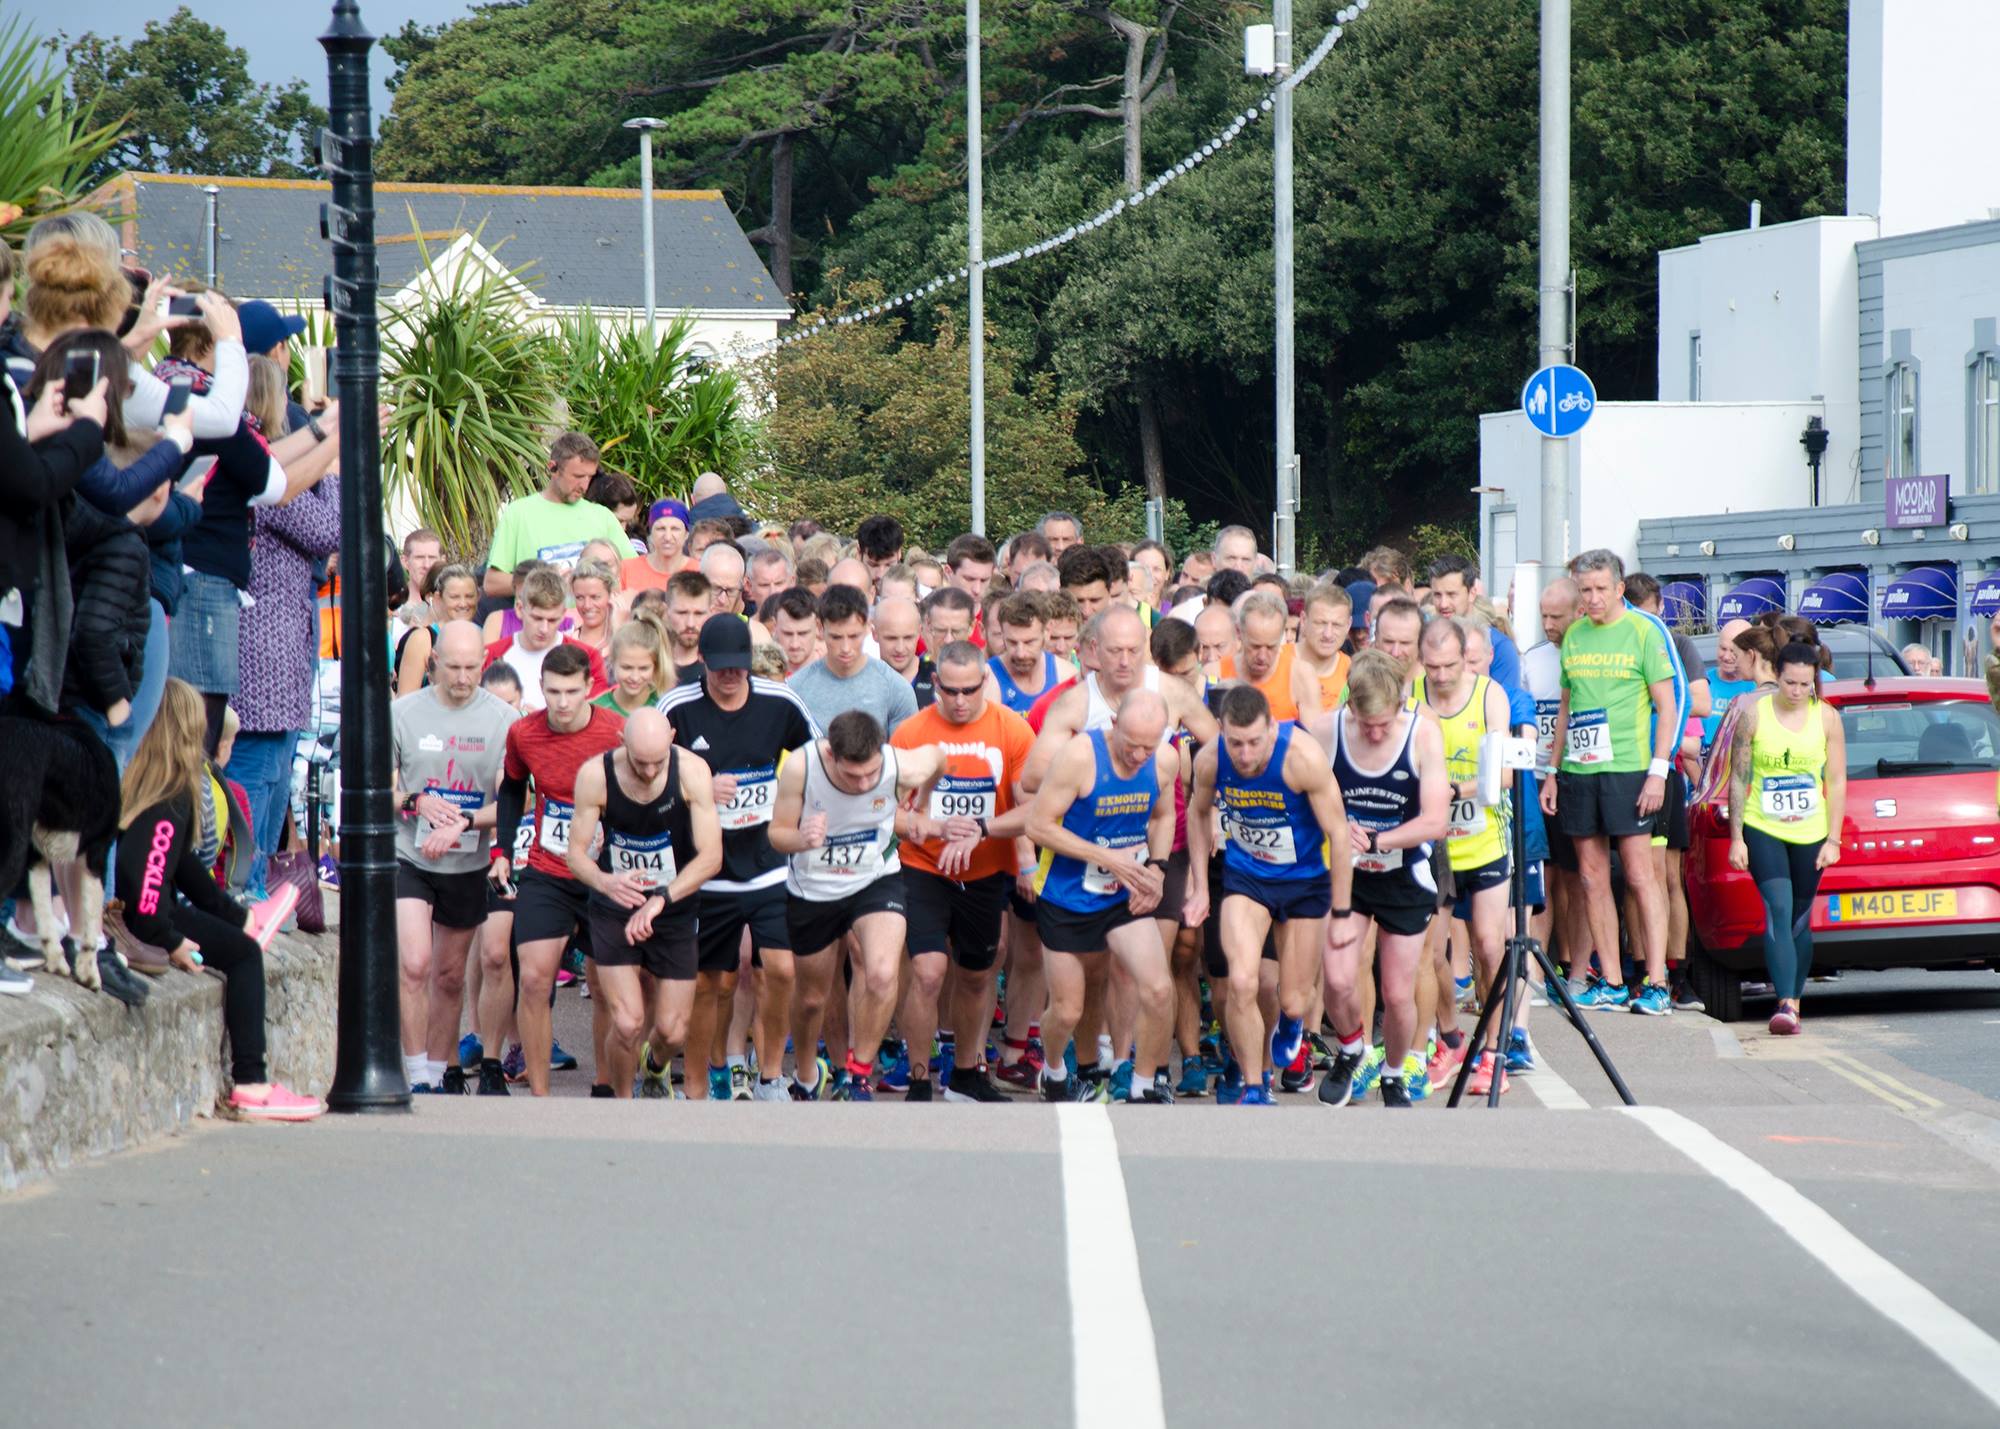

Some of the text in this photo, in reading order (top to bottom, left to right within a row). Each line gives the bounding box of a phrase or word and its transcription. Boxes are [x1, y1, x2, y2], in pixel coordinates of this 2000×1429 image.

[1894, 480, 1936, 515] MOOBAR
[1602, 669, 1631, 680] CLUB
[1572, 727, 1601, 749] 597
[1097, 792, 1151, 806] EXMOUTH
[1224, 786, 1284, 800] EXMOUTH
[1773, 791, 1810, 811] 815
[941, 794, 985, 816] 999
[1094, 804, 1149, 816] HARRIERS
[1367, 801, 1399, 809] Runners
[1239, 826, 1284, 848] 822
[620, 851, 664, 870] 904
[820, 845, 866, 865] 437
[139, 820, 175, 915] COCKLES
[1852, 893, 1944, 916] M40 EJF
